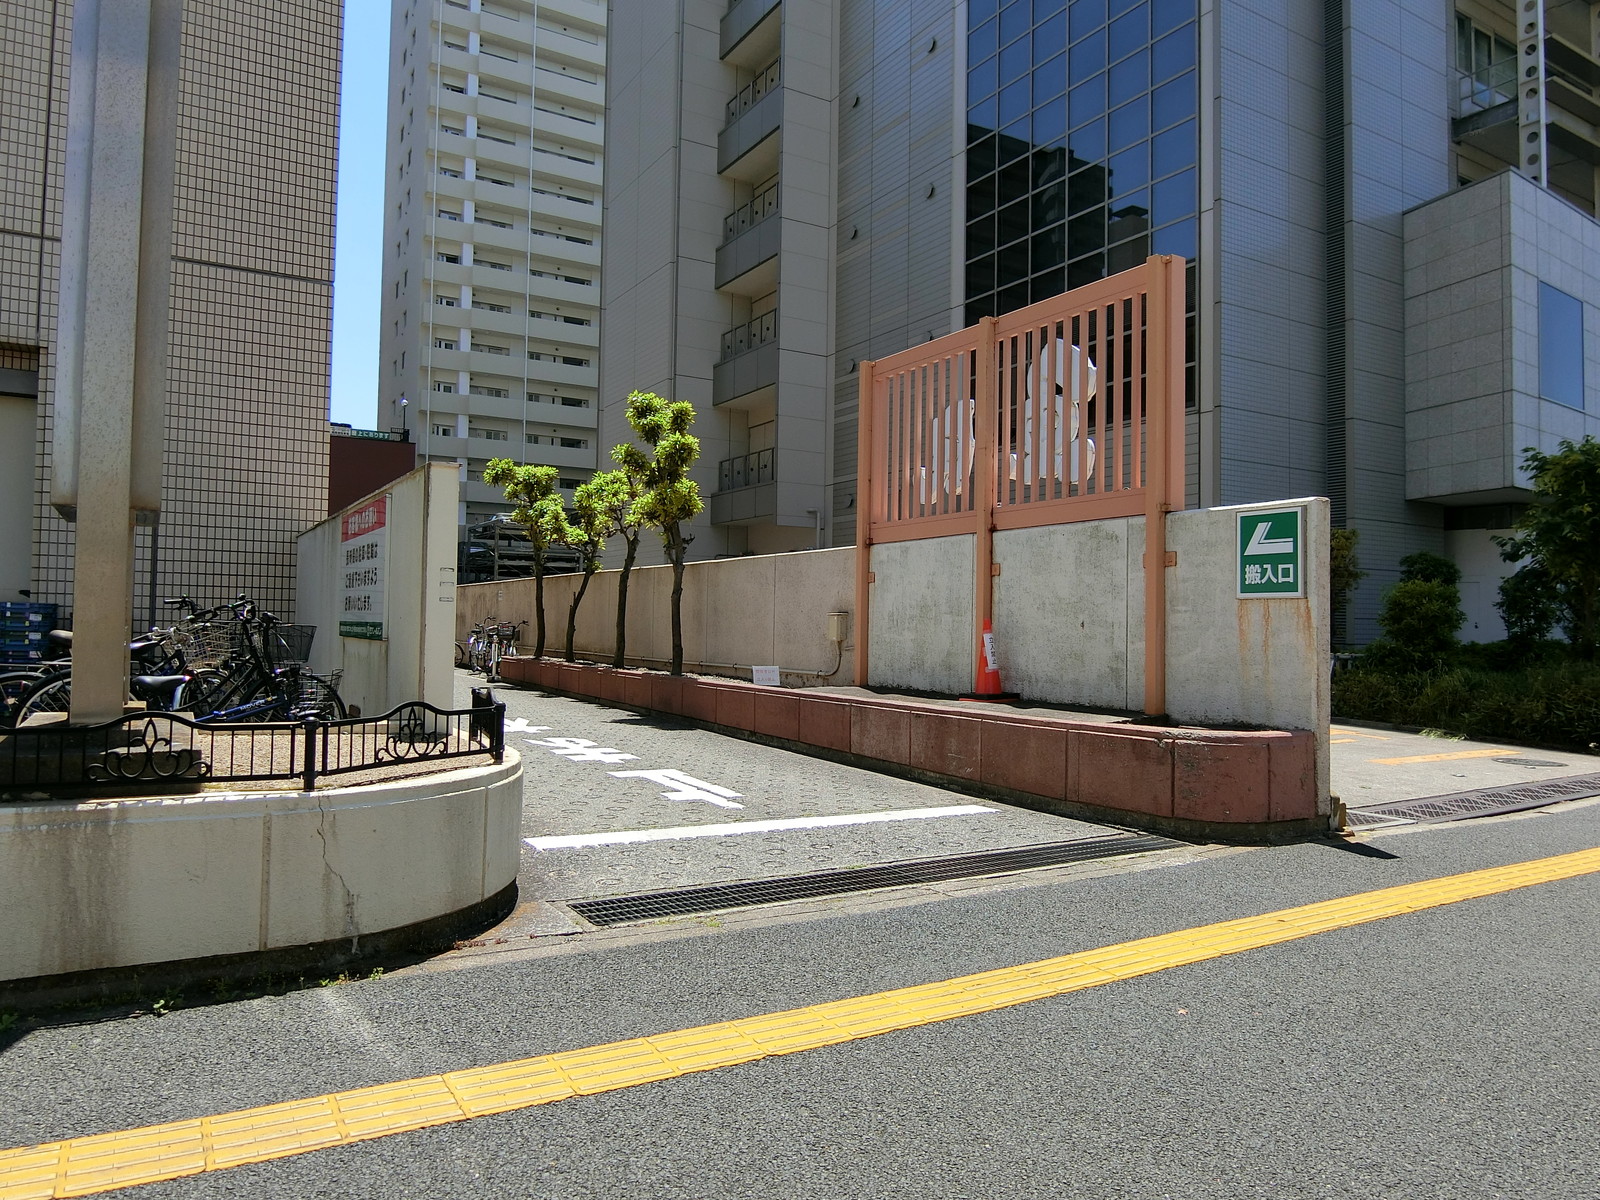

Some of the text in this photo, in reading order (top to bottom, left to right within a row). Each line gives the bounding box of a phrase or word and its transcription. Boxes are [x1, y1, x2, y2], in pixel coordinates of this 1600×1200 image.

[351, 430, 389, 439] 上にあります
[1245, 564, 1294, 585] 搬入口
